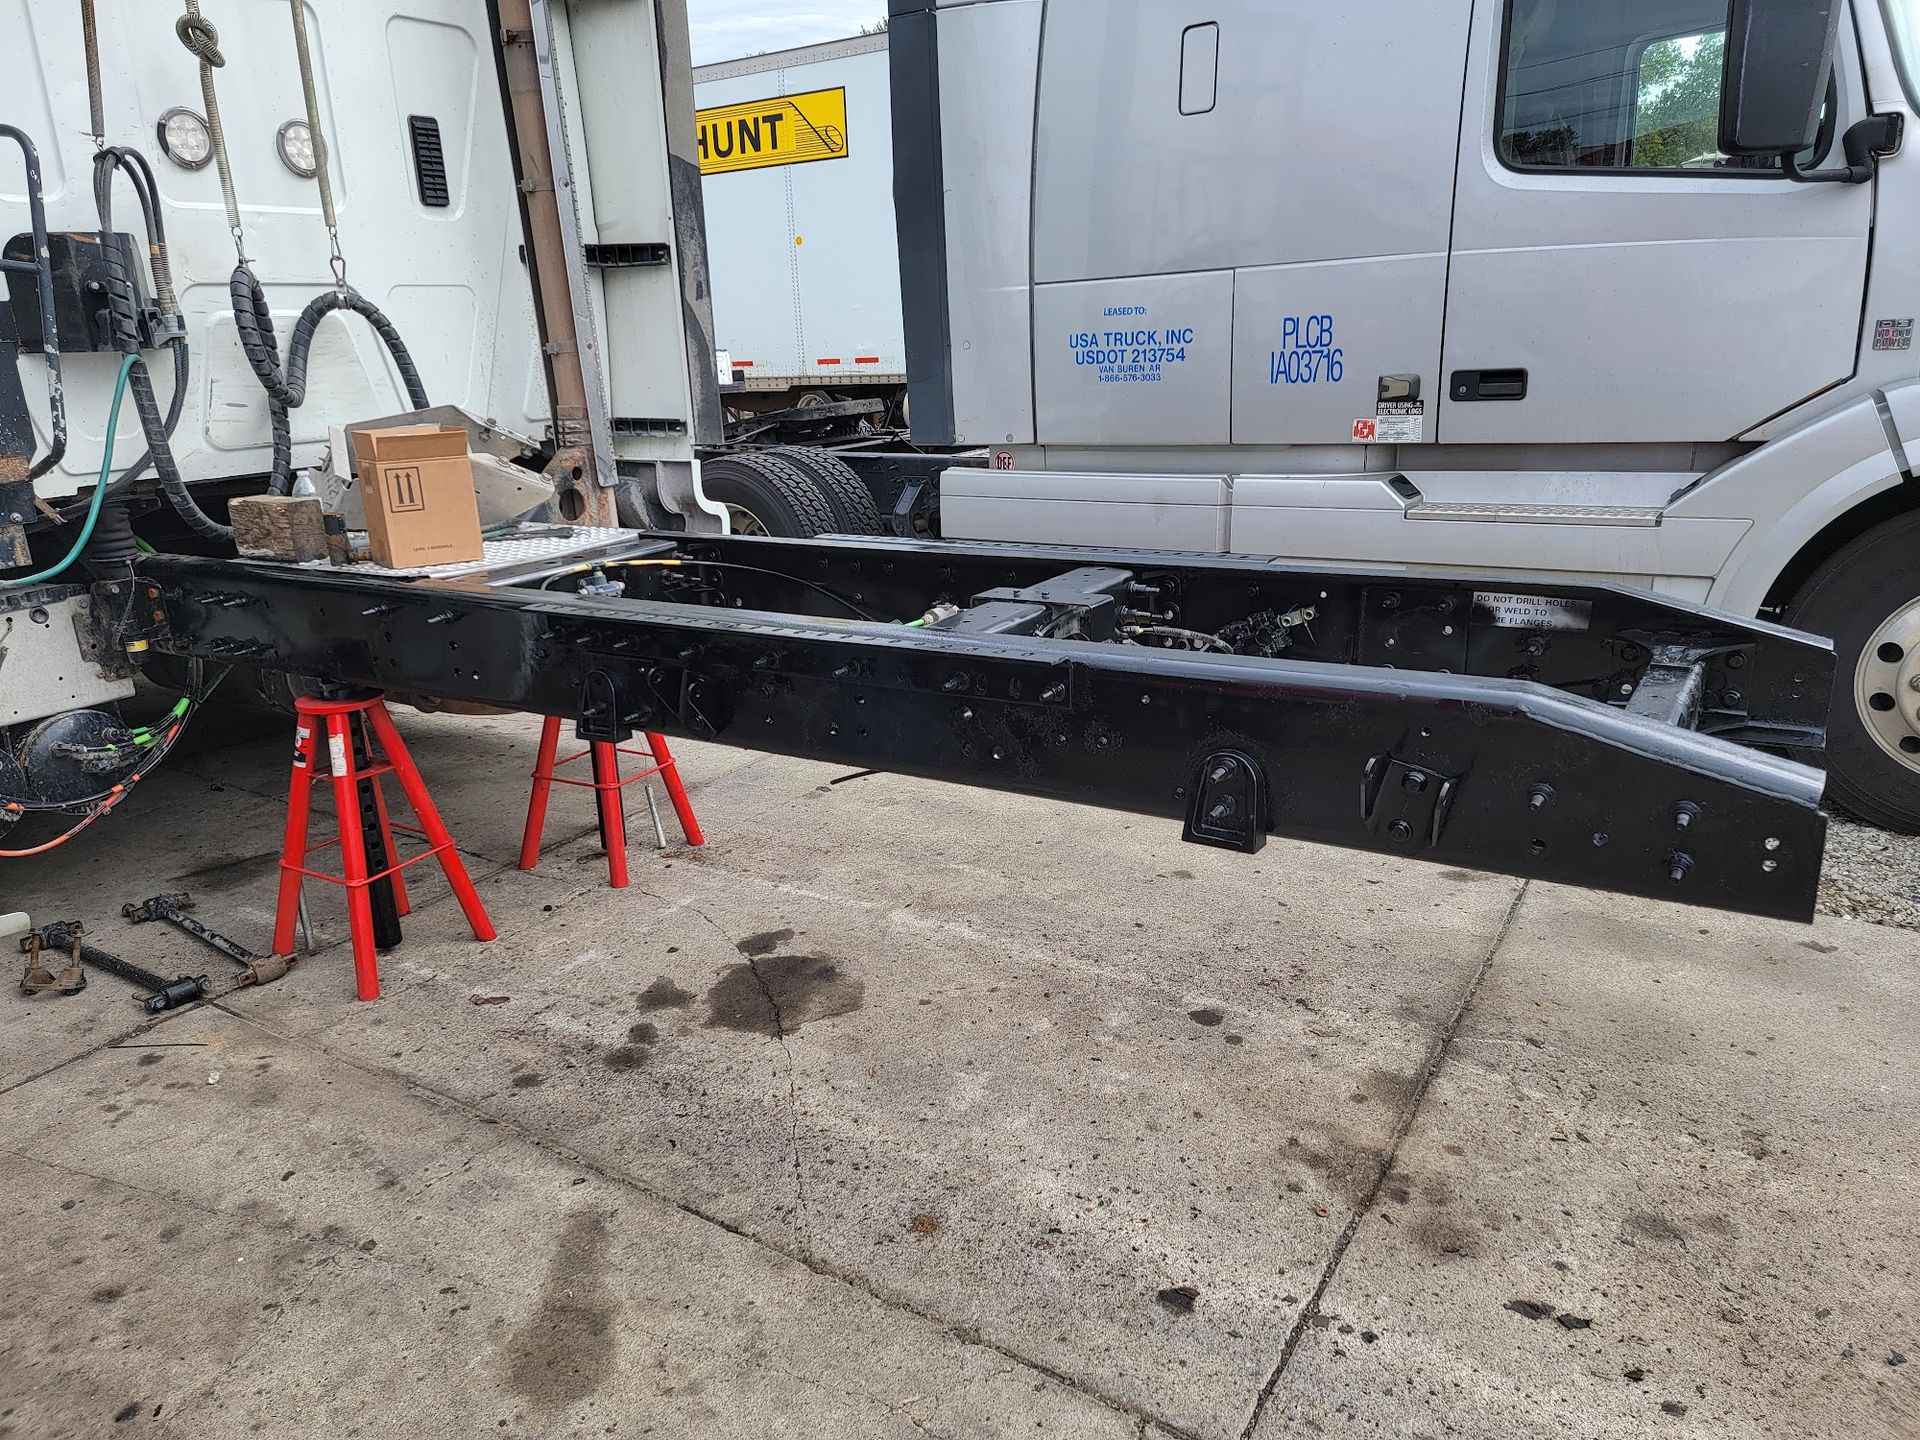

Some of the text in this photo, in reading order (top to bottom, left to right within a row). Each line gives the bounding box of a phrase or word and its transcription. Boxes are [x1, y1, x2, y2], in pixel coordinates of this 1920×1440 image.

[1103, 306, 1147, 316] LEASED TO:
[1069, 328, 1194, 349] USA TRUCK, INC
[1283, 315, 1333, 349] PLCB
[1075, 347, 1186, 365] USDOT 213754
[1098, 364, 1161, 374] VAN BUREN AR
[1270, 348, 1343, 384] IA03716
[1098, 373, 1162, 382] 1-866-576-3033
[1476, 594, 1577, 608] DO NOT DRILL HOLES
[1488, 605, 1501, 614] OR
[1504, 606, 1531, 615] WELD
[1534, 608, 1547, 617] TO
[1509, 616, 1552, 628] FLANGES
